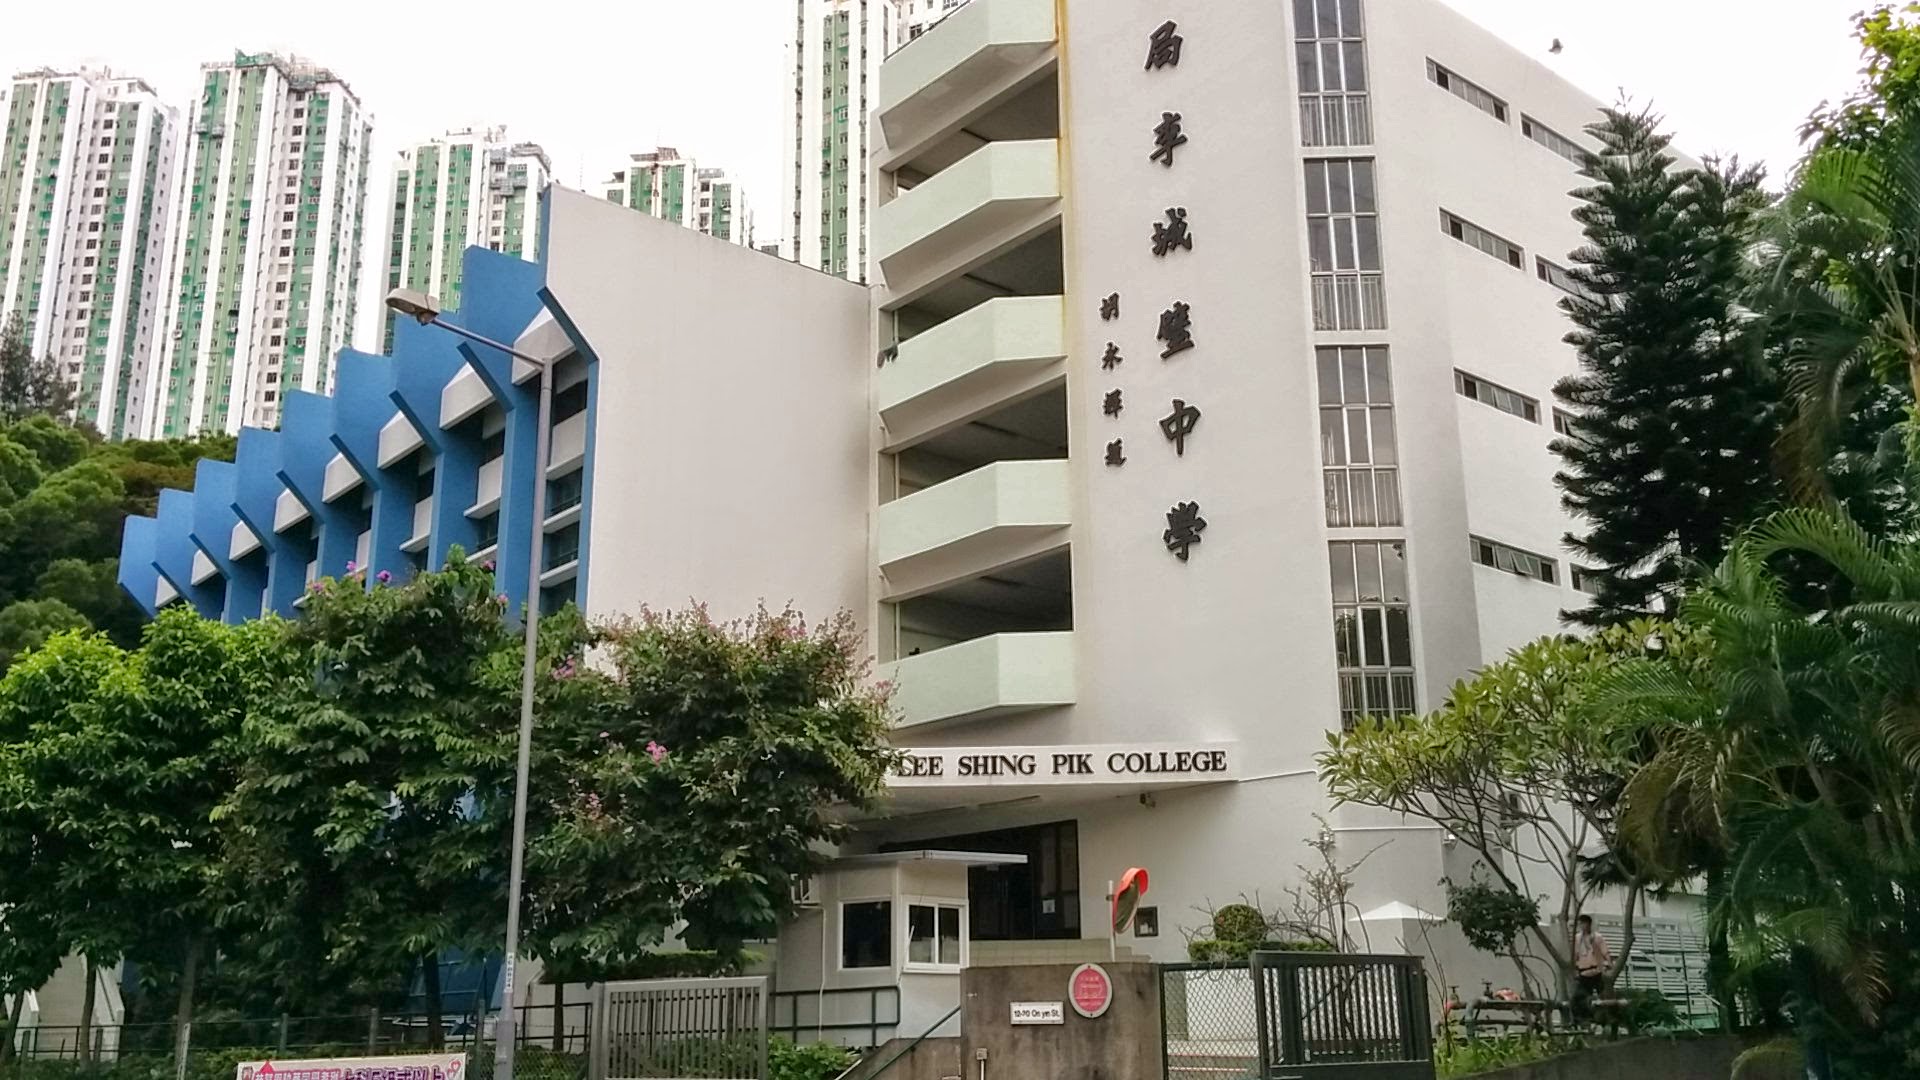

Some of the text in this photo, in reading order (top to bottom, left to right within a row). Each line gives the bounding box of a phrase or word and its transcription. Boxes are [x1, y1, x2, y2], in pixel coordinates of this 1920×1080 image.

[957, 754, 1036, 776] SHING
[1052, 753, 1094, 775] PIK
[1107, 750, 1227, 774] COLLEGE
